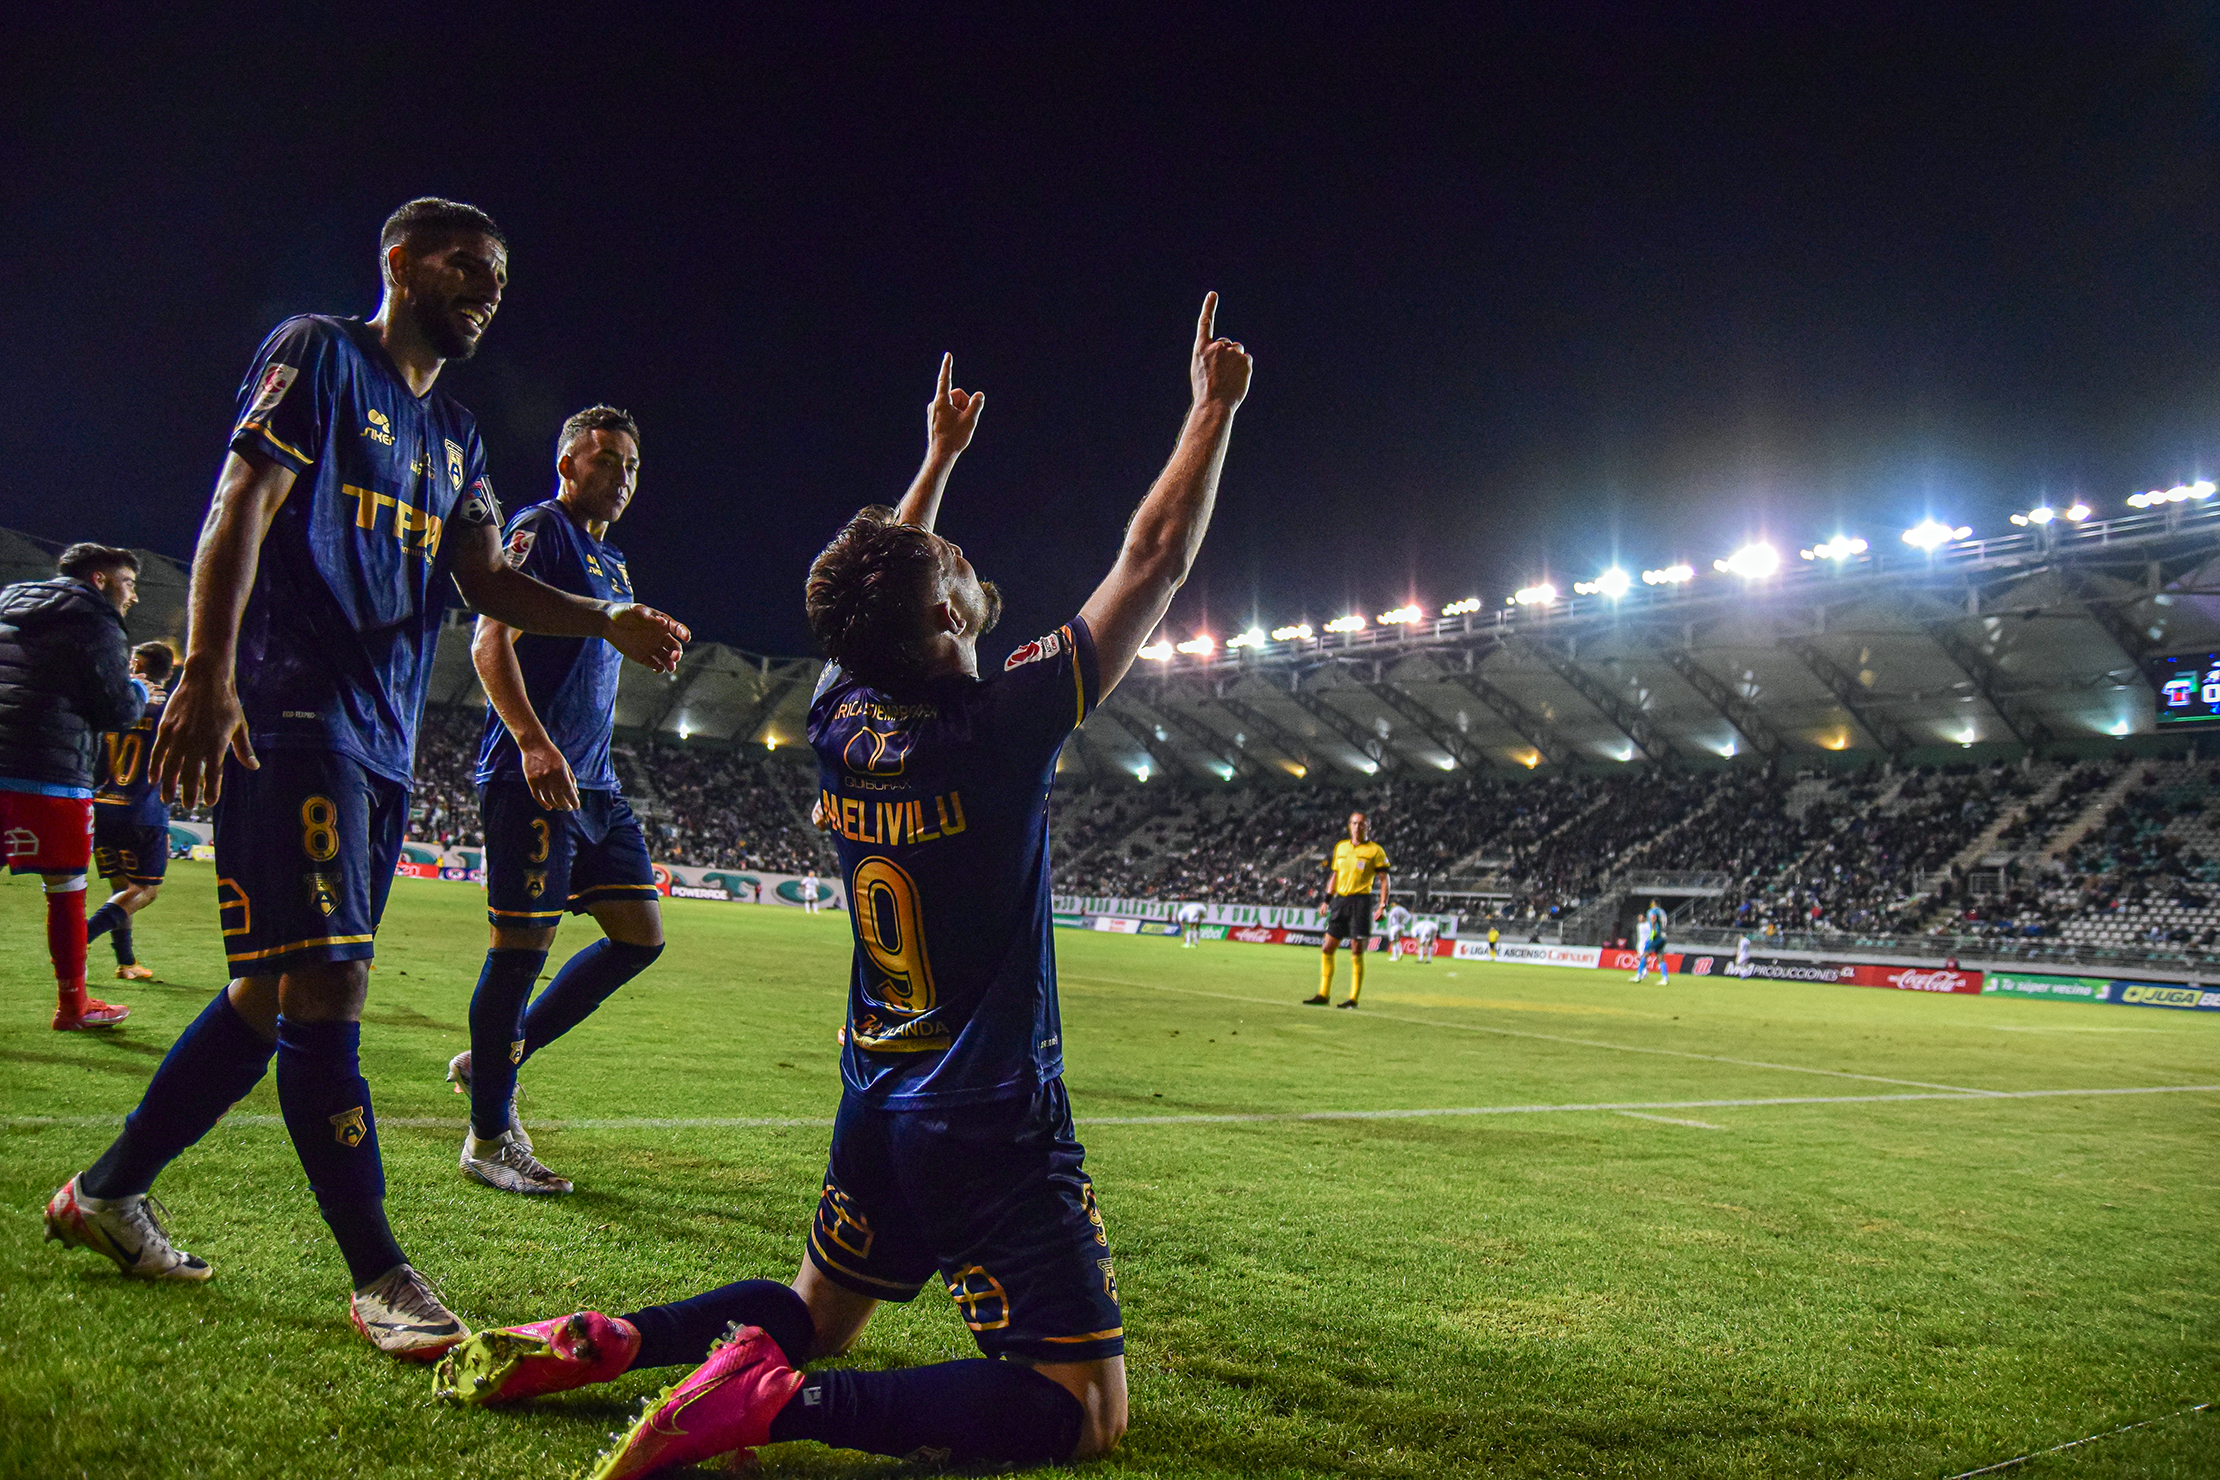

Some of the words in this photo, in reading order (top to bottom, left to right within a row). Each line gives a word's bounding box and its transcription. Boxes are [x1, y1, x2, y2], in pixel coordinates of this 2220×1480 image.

[341, 483, 443, 558] TPA
[105, 732, 141, 786] 10
[845, 775, 912, 791] QUIBORAX
[301, 796, 340, 862] 8
[821, 789, 967, 847] MELIVILU
[529, 818, 550, 863] 3
[671, 886, 729, 900] POWERADE
[852, 855, 936, 1018] 9
[1470, 946, 1489, 956] LIGA
[1504, 949, 1547, 960] ASCENSO
[1614, 953, 1660, 970] rosn
[2052, 984, 2093, 996] vecino
[2145, 990, 2195, 1004] JUGA
